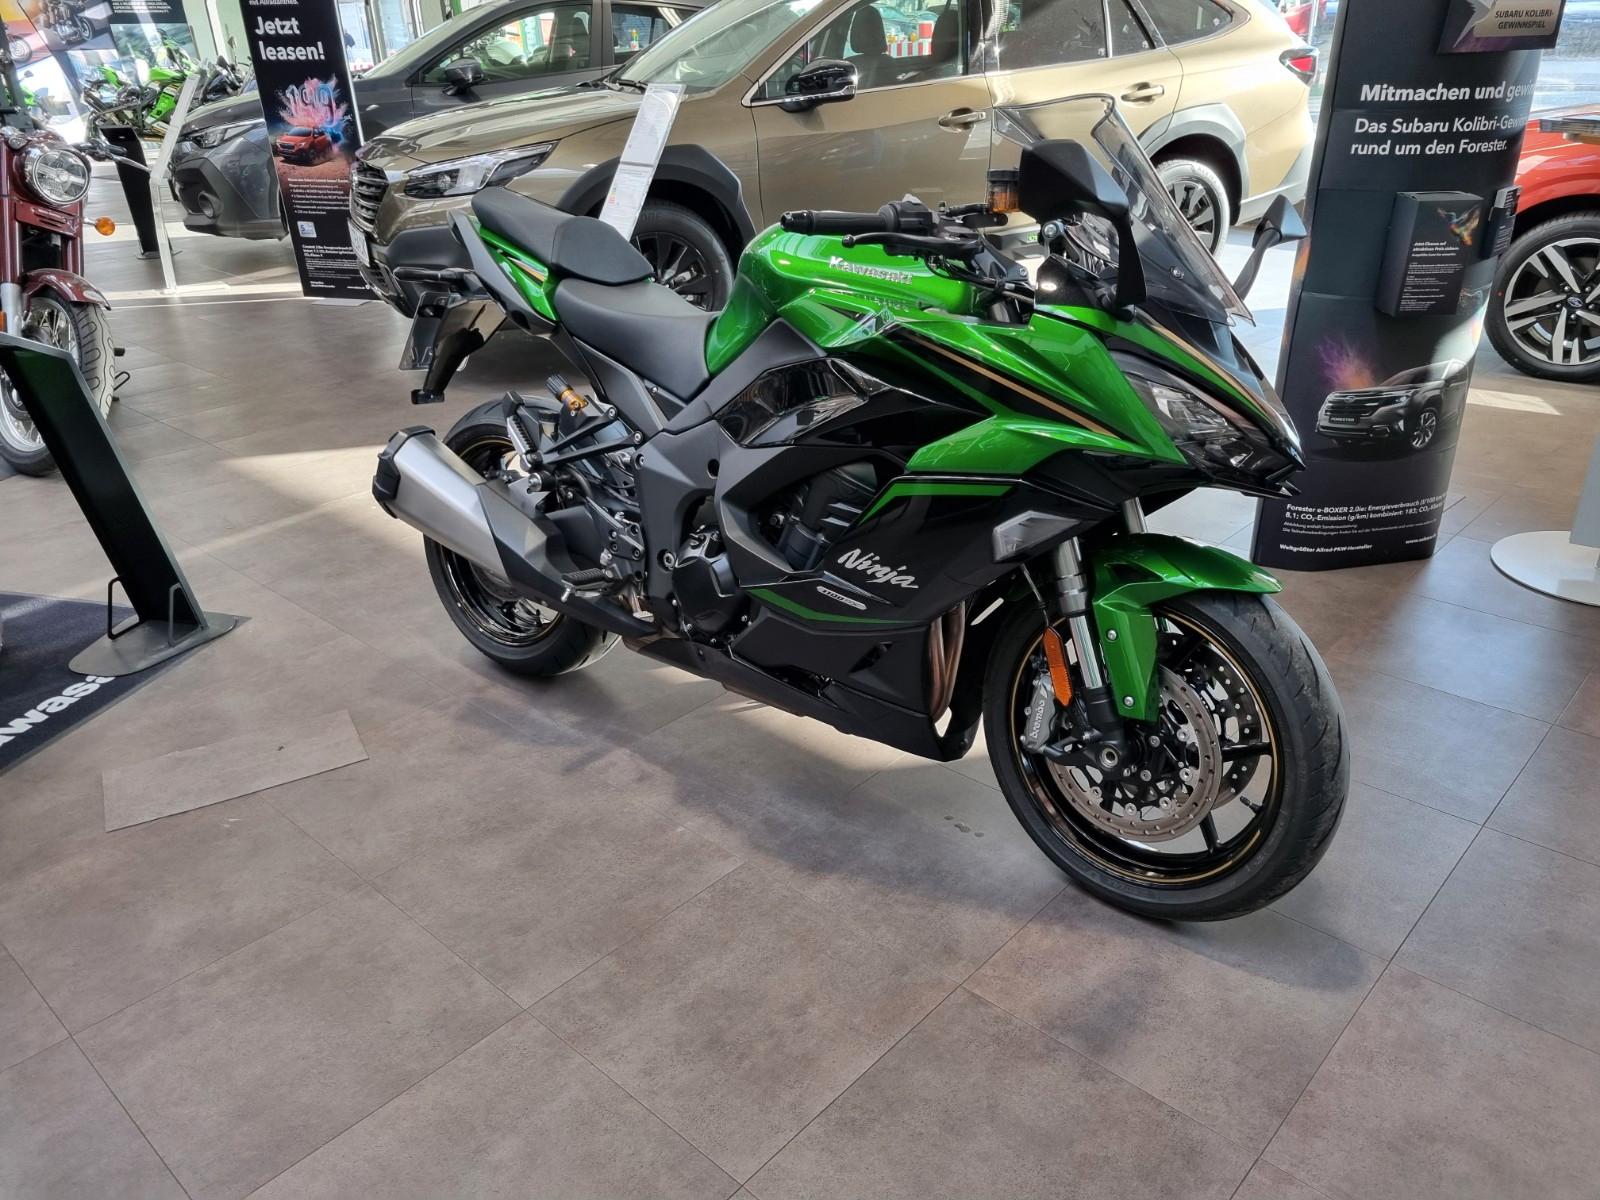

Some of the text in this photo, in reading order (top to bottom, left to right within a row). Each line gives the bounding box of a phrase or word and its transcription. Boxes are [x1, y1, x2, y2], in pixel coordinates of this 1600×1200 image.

[1494, 8, 1554, 19] SUBARU KOLIBRI-
[255, 15, 301, 35] Jetzt
[1498, 20, 1545, 30] GEWINNSPIEL
[258, 40, 325, 60] leasen!
[1360, 82, 1470, 102] Mitmachen
[1474, 81, 1506, 100] und
[1354, 117, 1387, 134] Das
[1391, 117, 1449, 134] Subaru
[1350, 138, 1507, 155] rund um den Forester.
[1286, 503, 1316, 513] Forester
[1316, 506, 1349, 514] e-BOXER
[1367, 501, 1420, 512] Energieverbrauch
[837, 548, 919, 589] Ninja
[1030, 700, 1046, 739] brembo
